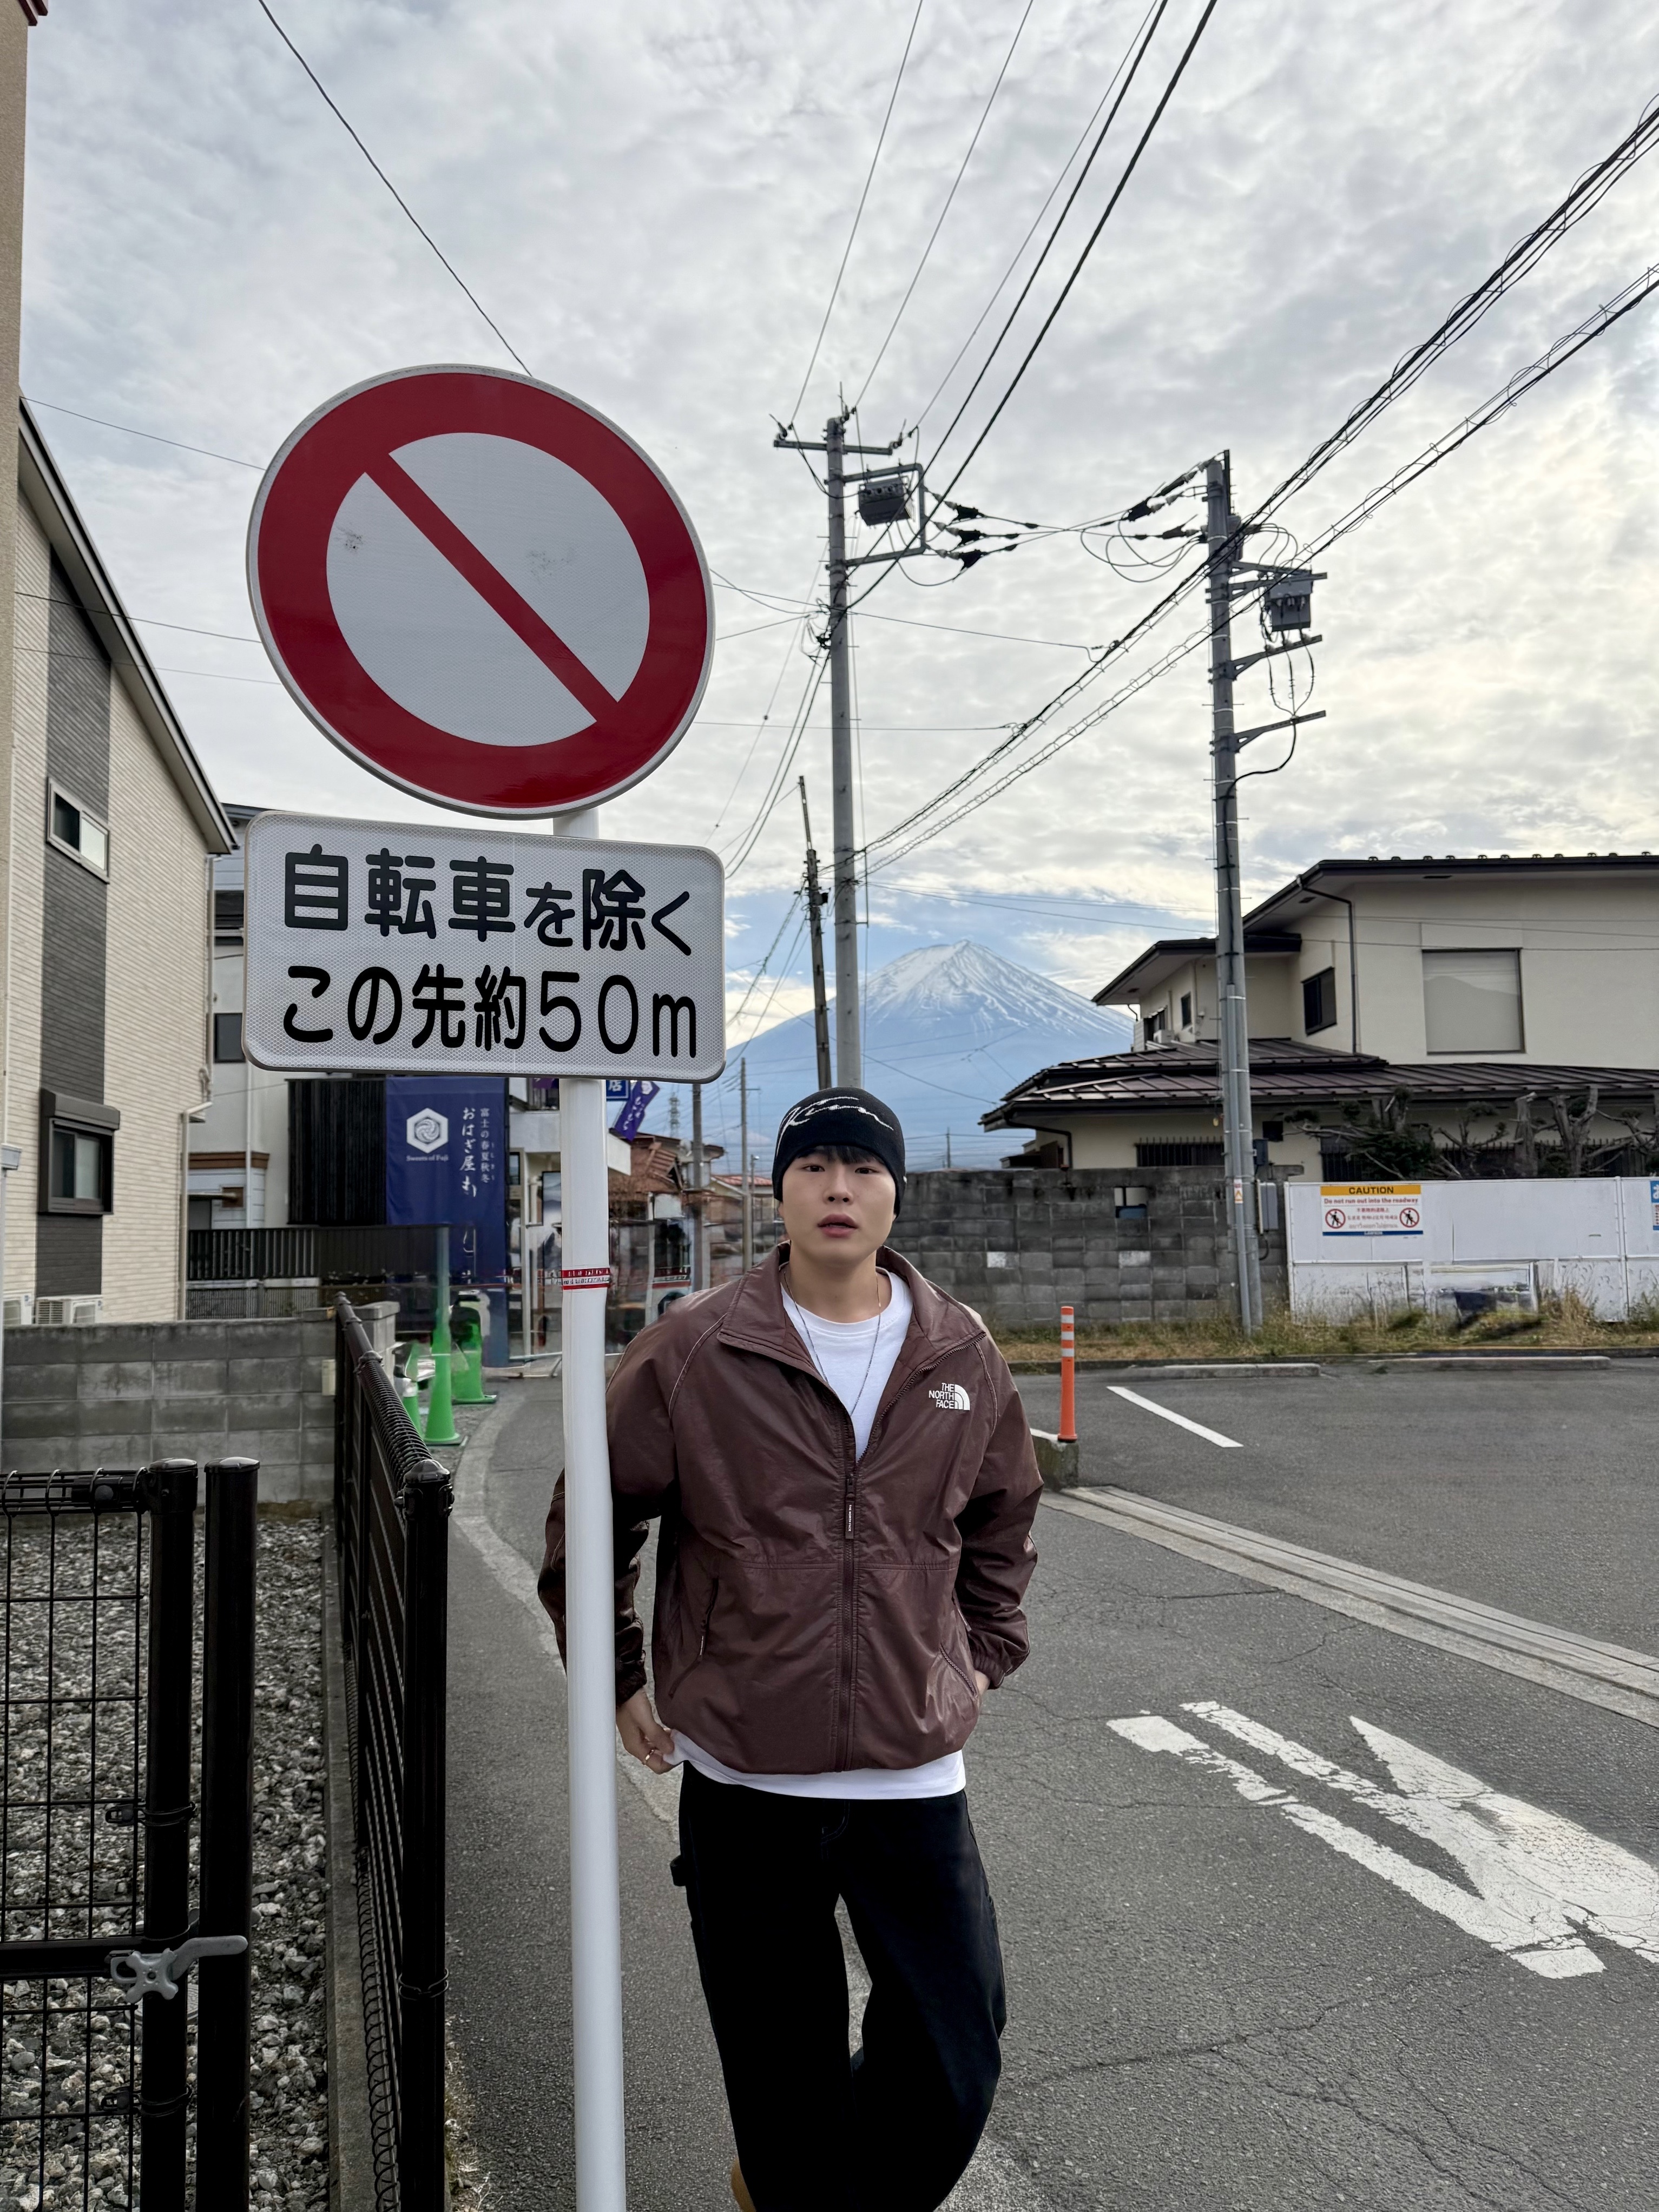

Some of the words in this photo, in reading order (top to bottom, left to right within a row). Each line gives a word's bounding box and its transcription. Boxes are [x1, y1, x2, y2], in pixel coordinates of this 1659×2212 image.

[284, 843, 692, 956] 自転車を除く
[282, 963, 697, 1058] この先約50m
[1349, 1186, 1394, 1194] CAUTION
[942, 1382, 954, 1392] THE
[929, 1390, 954, 1401] NORTH
[936, 1399, 954, 1409] FACE
